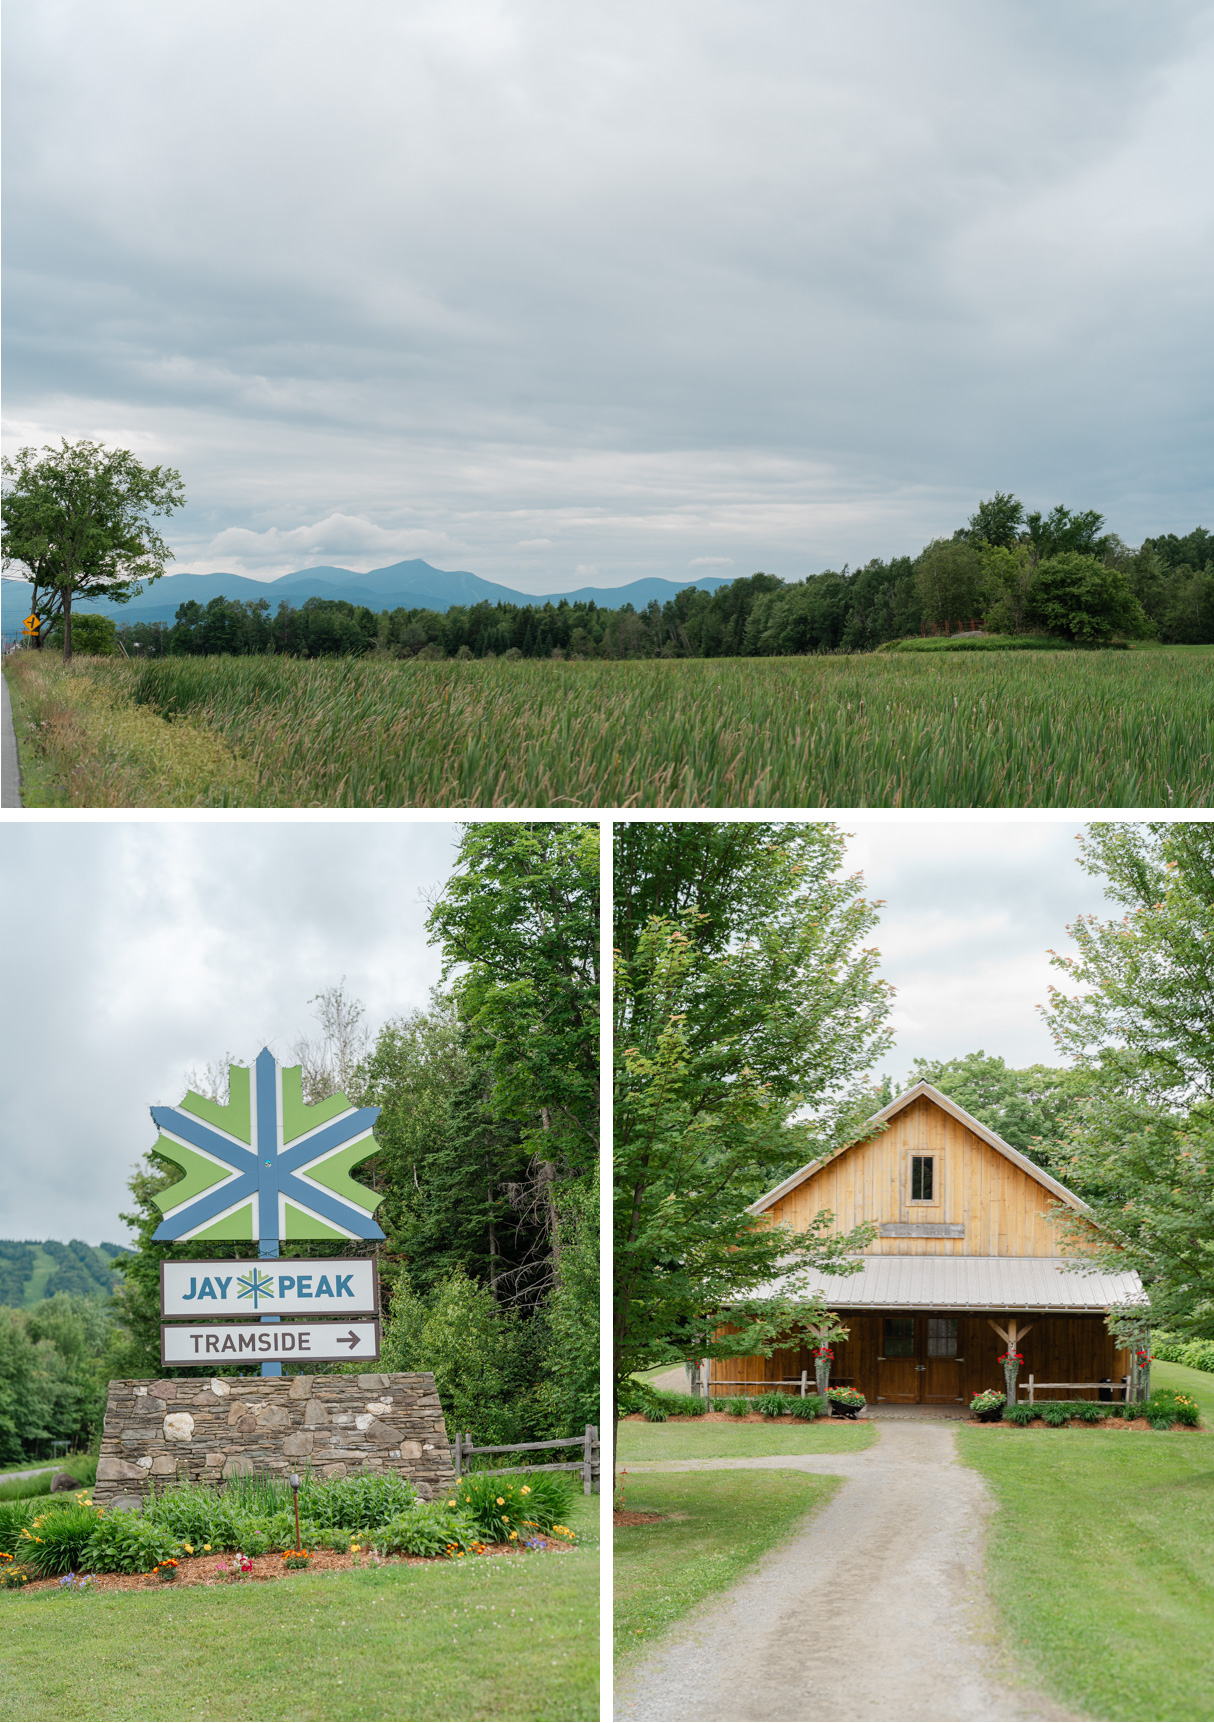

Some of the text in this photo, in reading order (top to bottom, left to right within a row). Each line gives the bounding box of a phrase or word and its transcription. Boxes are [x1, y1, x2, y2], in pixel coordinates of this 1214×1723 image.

[182, 1275, 354, 1300] JAY PEAK
[190, 1332, 311, 1353] TRAMSIDE
